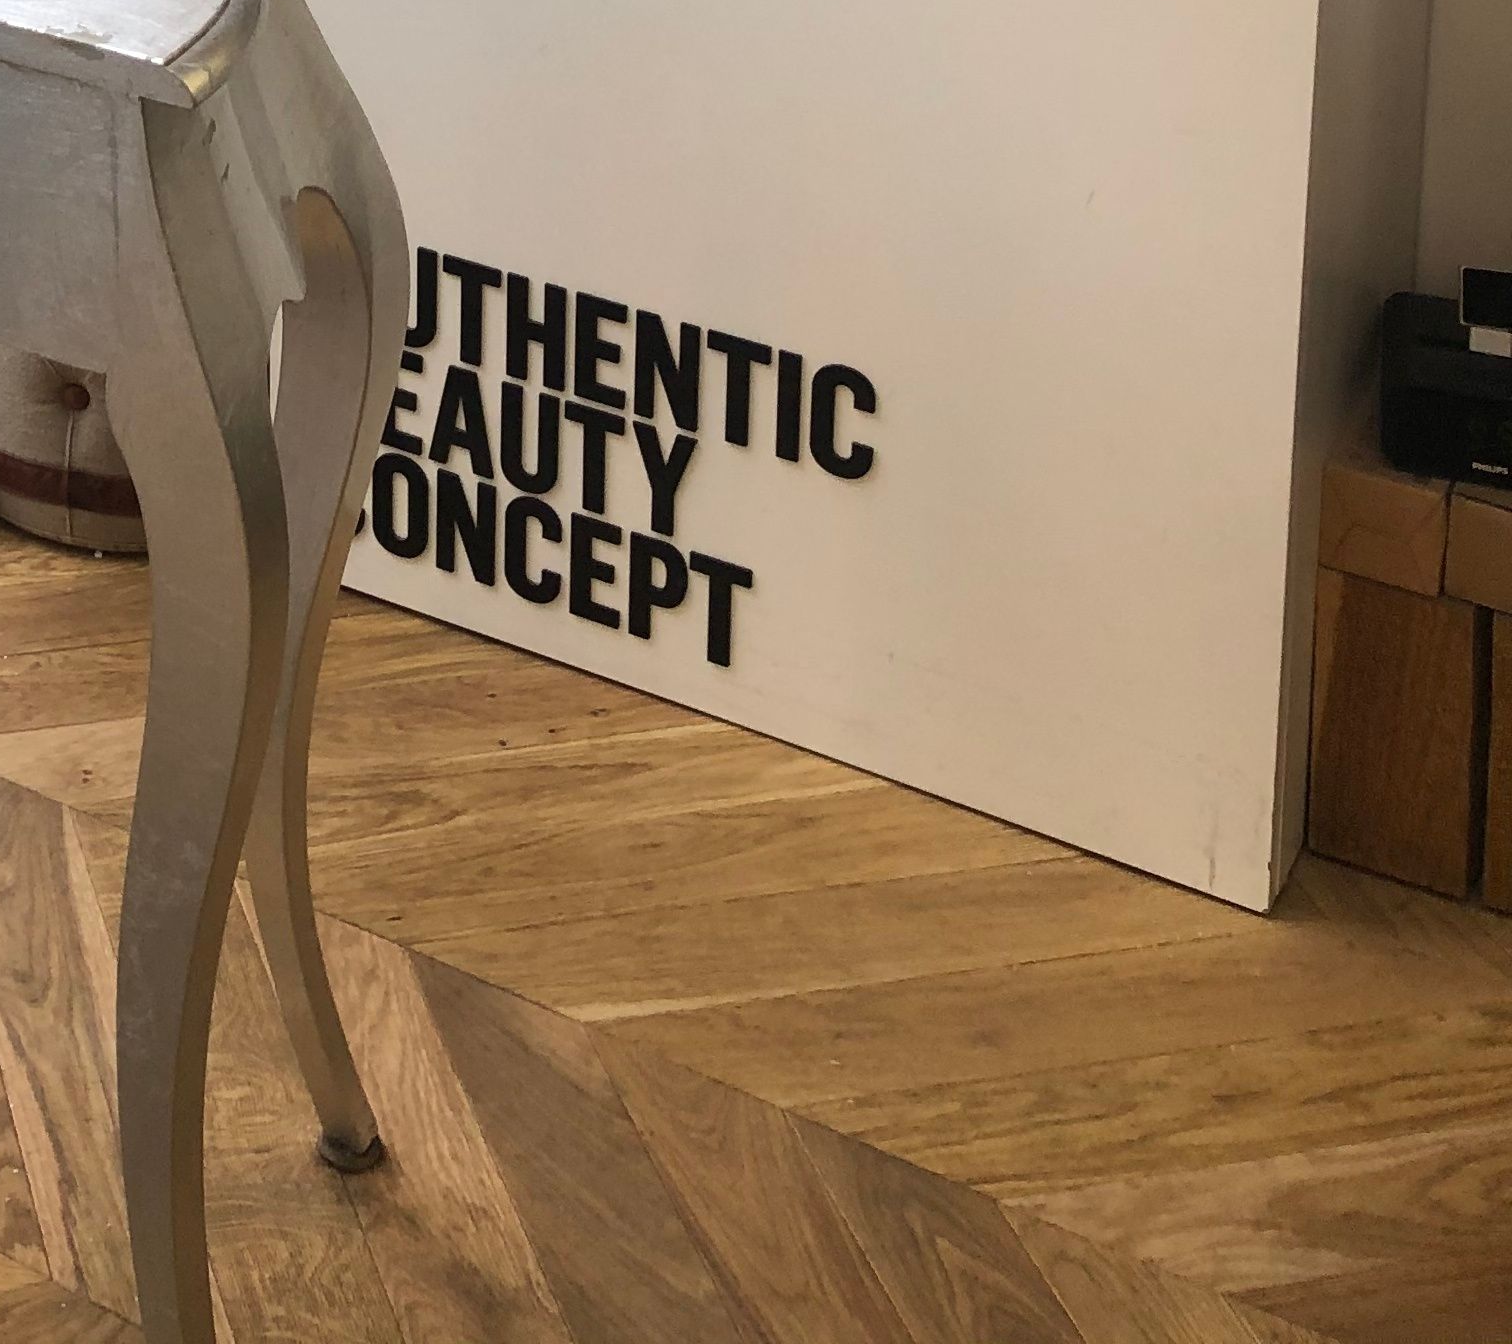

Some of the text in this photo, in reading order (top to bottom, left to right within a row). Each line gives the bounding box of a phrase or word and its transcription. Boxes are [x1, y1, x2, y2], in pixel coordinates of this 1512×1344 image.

[382, 351, 698, 537] EAUTY
[404, 246, 876, 479] UTHENTIC
[356, 452, 753, 668] ONCEPT
